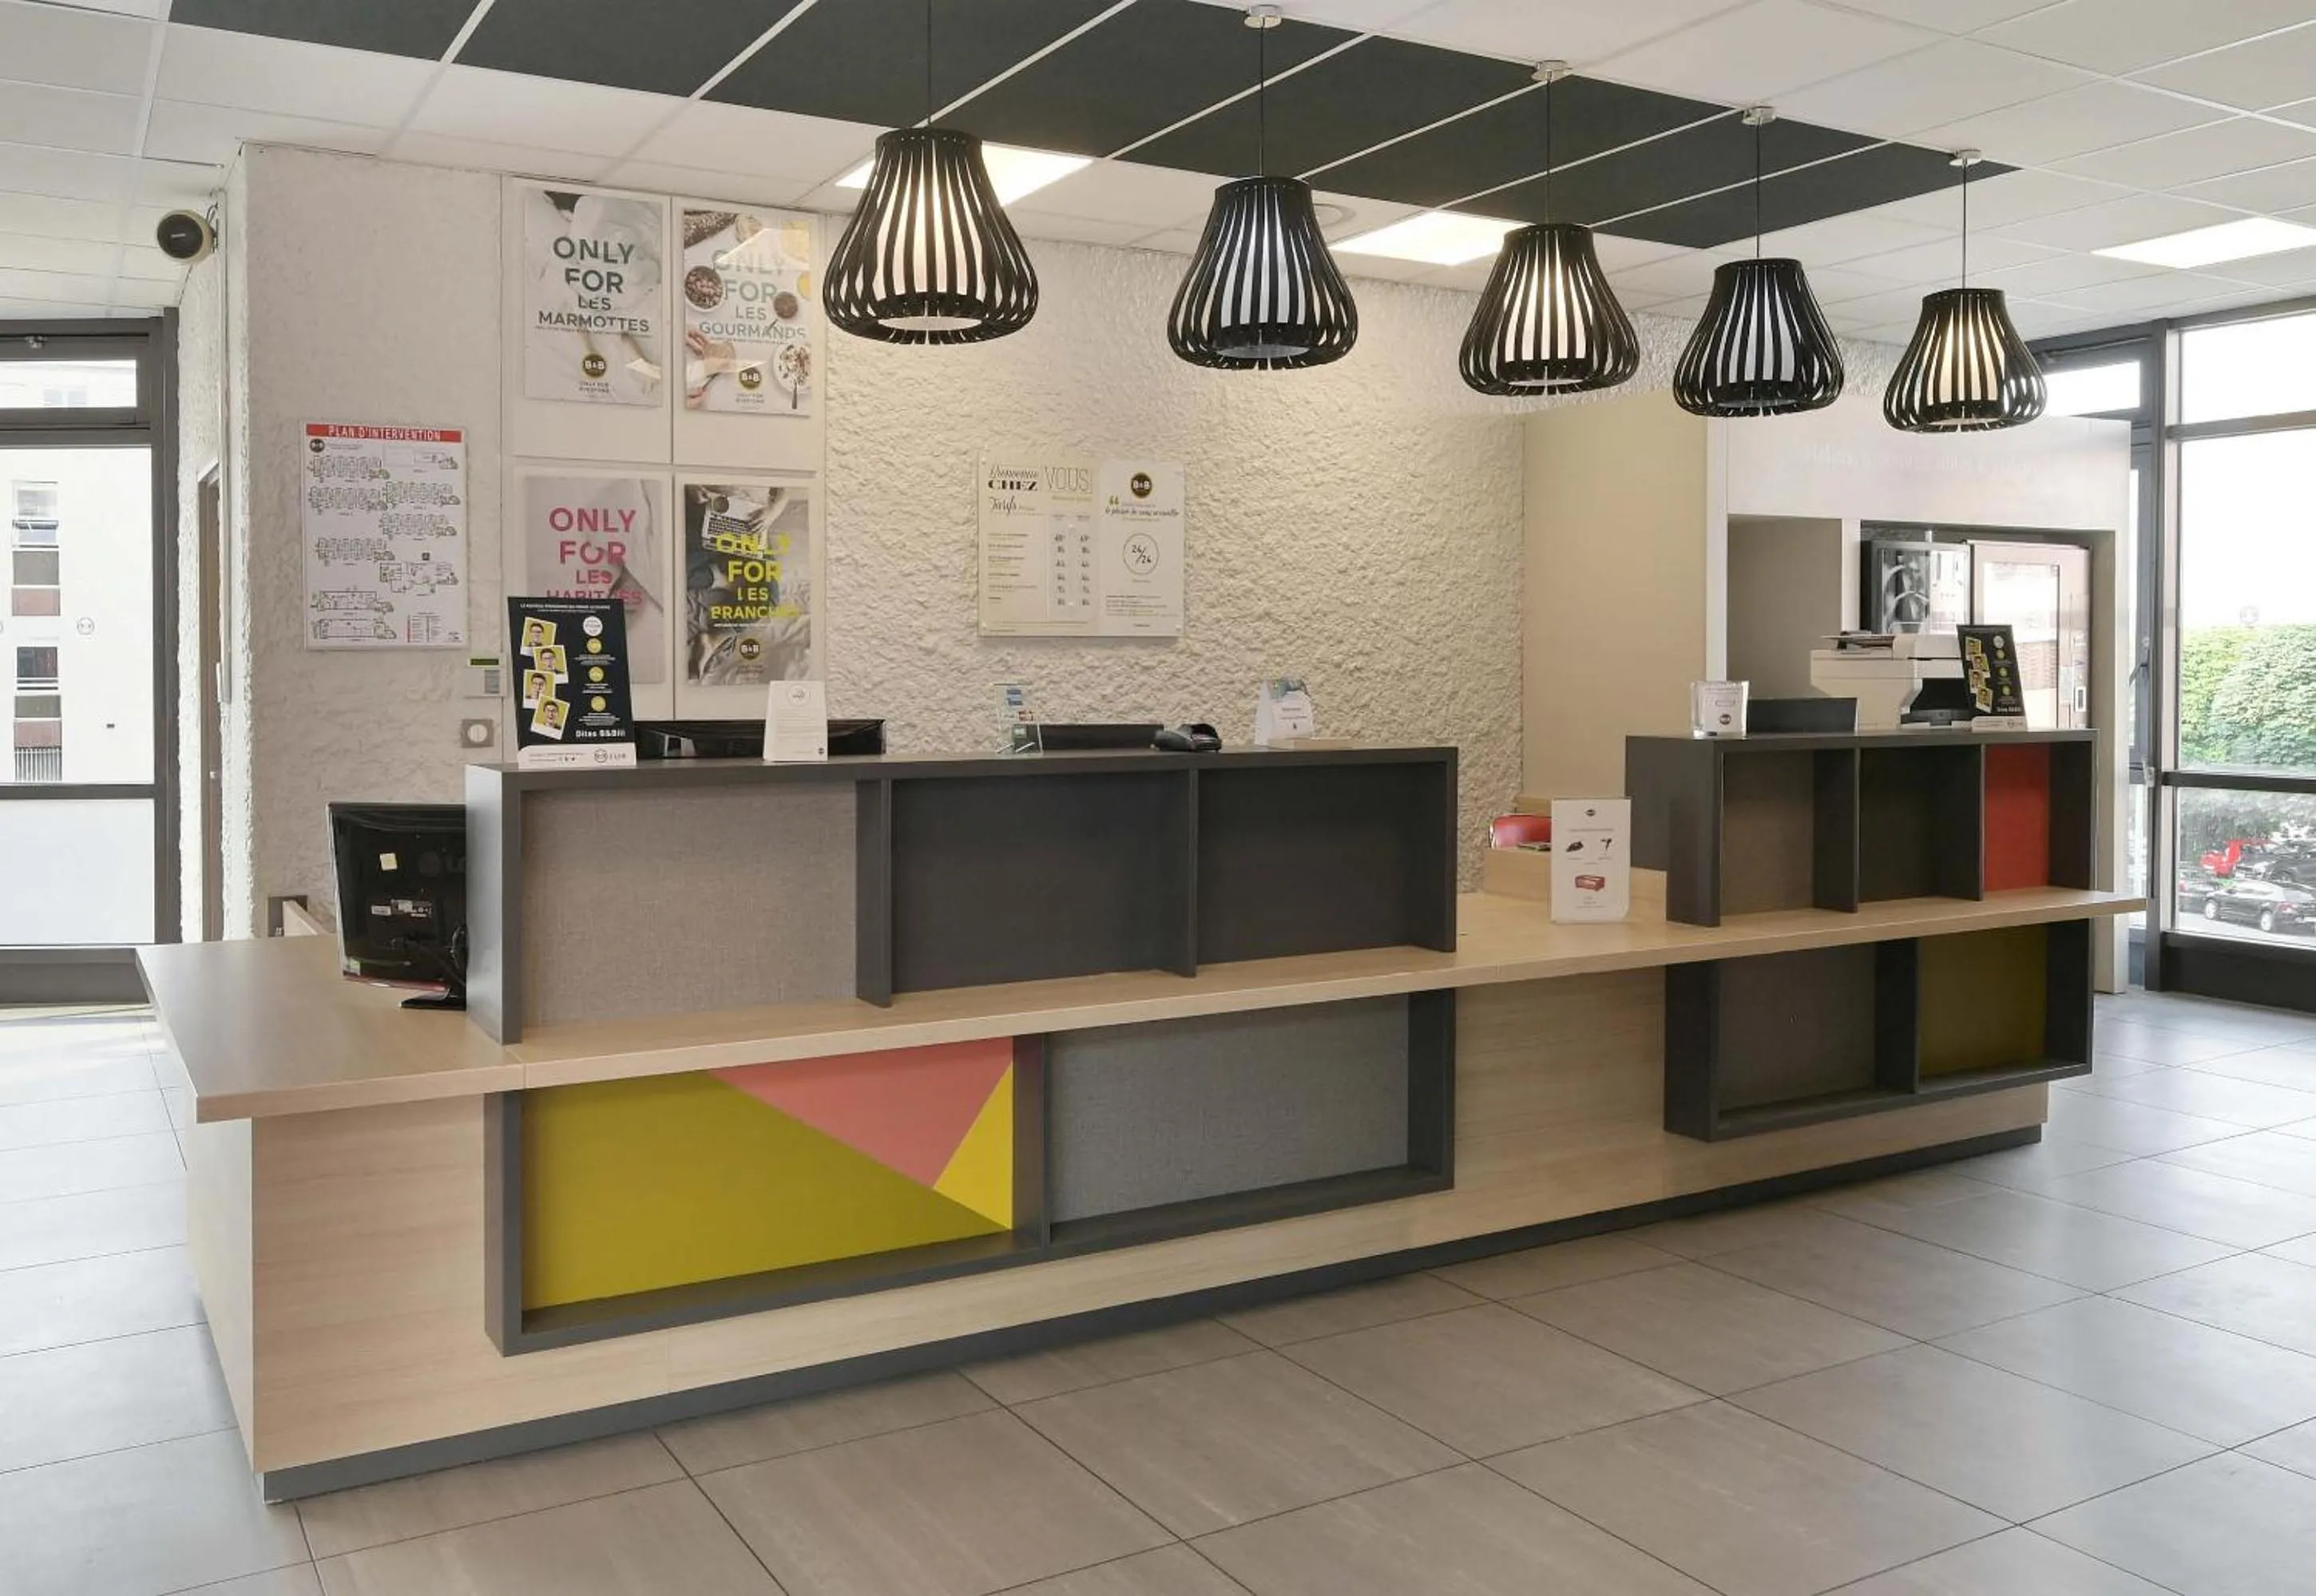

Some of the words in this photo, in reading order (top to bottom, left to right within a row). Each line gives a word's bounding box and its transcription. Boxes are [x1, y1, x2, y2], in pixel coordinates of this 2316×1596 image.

[553, 236, 634, 264] ONLY
[712, 249, 785, 275] ONLY
[565, 267, 624, 294] FOR
[724, 280, 778, 303] FOR
[577, 294, 612, 311] LES
[736, 306, 767, 320] LES
[538, 311, 649, 332] MARMOTTES
[699, 322, 807, 340] GOURMANDS
[327, 426, 355, 438] PLAN
[359, 427, 440, 442] D'INTERVENTION
[987, 479, 1038, 492] CHEZ
[1044, 466, 1090, 492] VOUS
[549, 507, 637, 533] ONLY
[559, 541, 626, 565] FOR
[576, 569, 613, 584] LES
[728, 560, 783, 583] FOR
[710, 604, 801, 620] BRANCH
